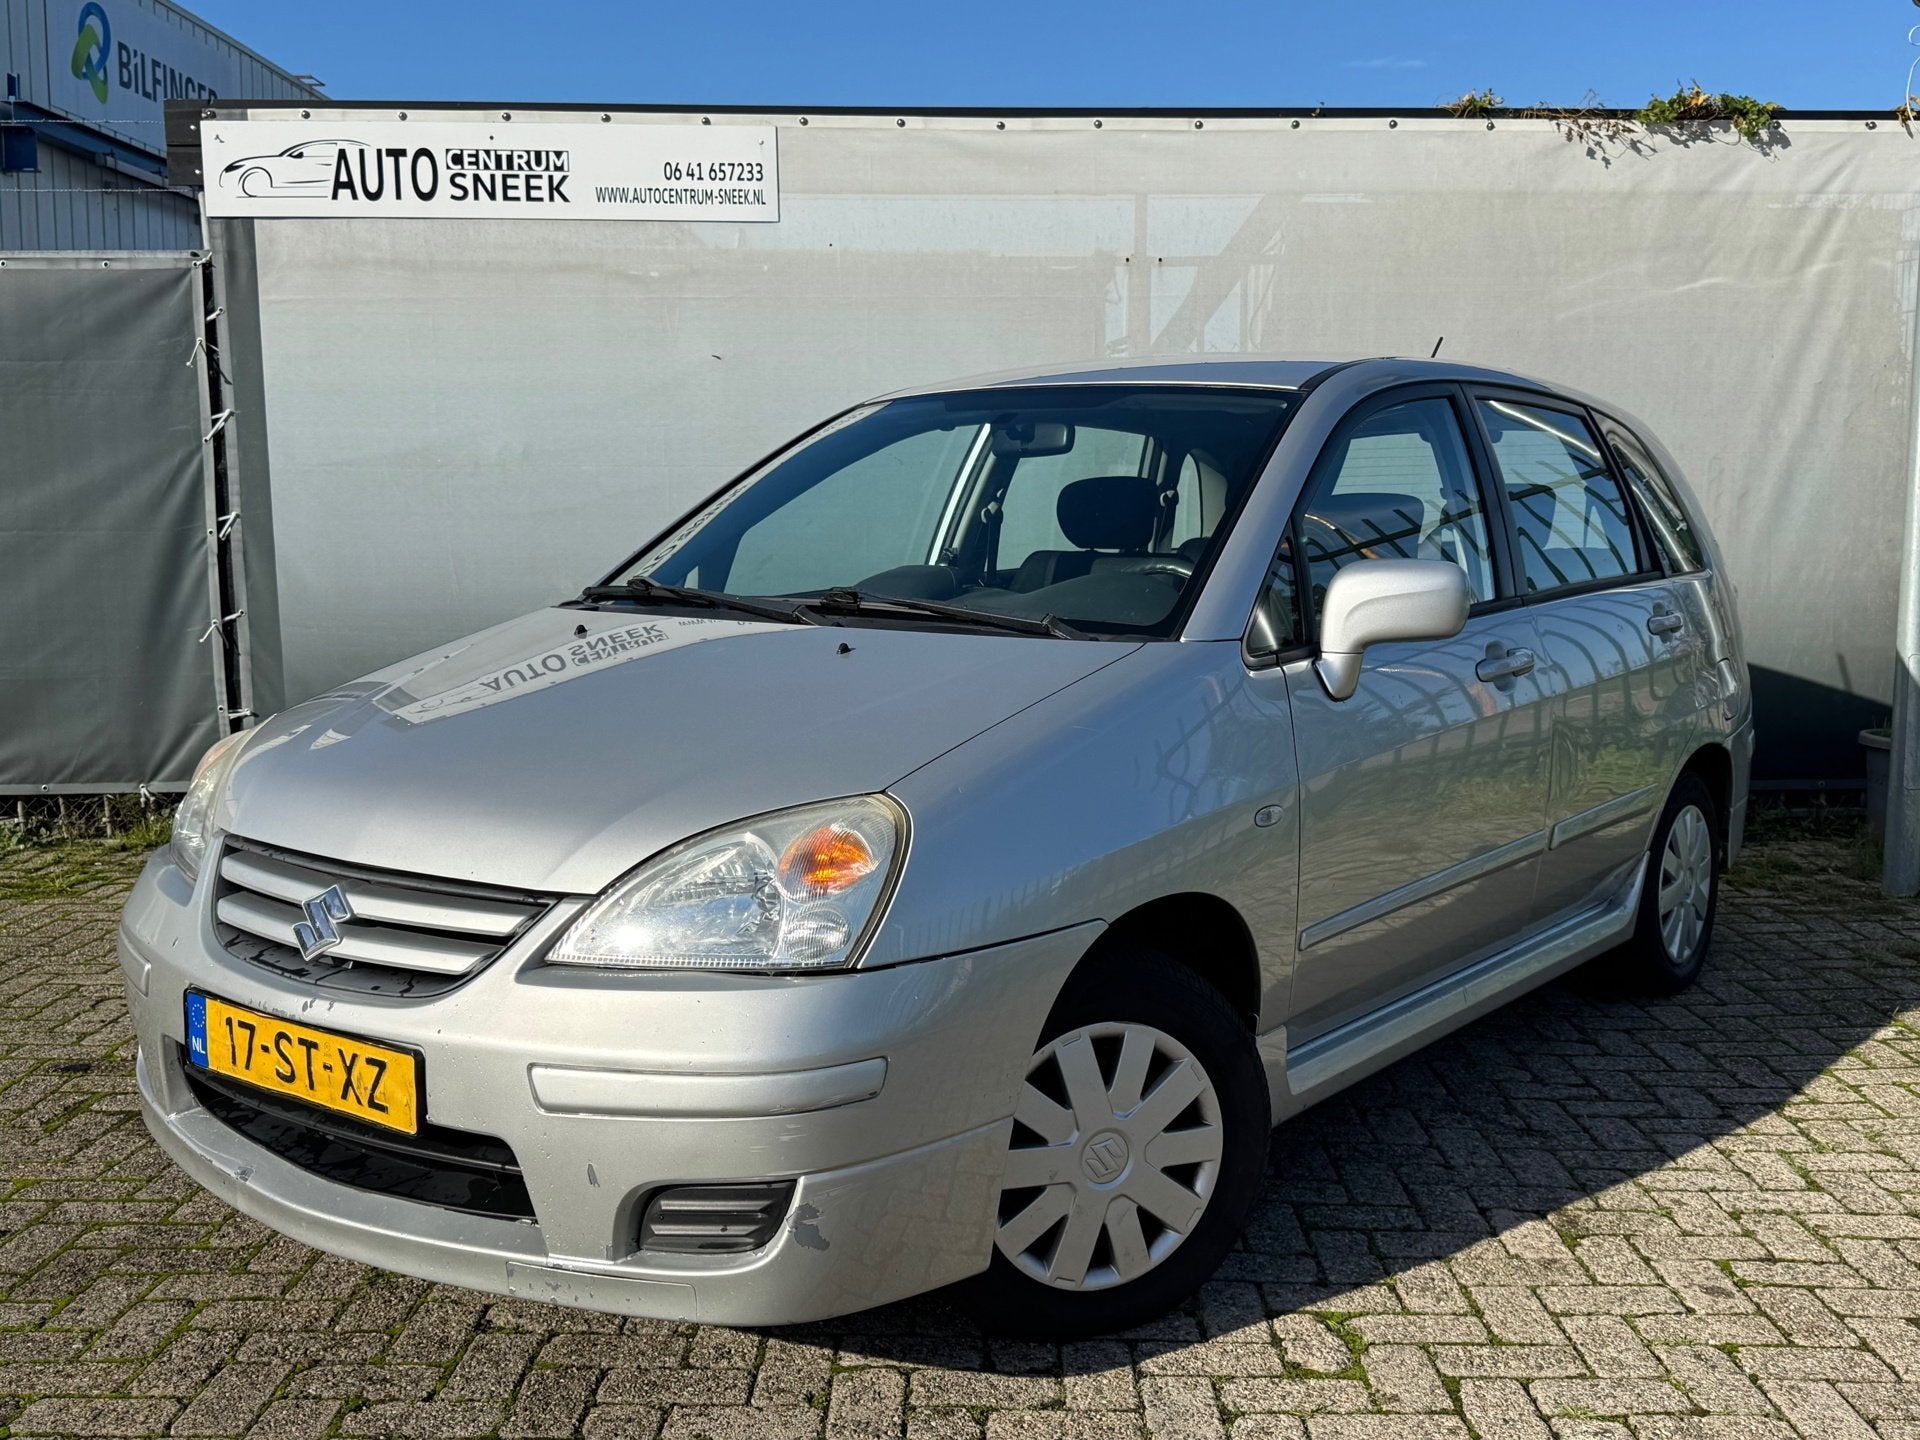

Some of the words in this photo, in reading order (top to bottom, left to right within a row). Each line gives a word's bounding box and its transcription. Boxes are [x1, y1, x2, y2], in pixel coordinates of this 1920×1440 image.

[446, 149, 570, 172] CENTRUM
[663, 161, 682, 181] 06
[686, 162, 704, 181] 41
[708, 162, 764, 182] 657233
[331, 147, 439, 202] AUTO
[450, 172, 571, 203] SNEEK
[595, 186, 767, 206] WWW.AUTOCENTRUM-SNEEK.NL
[192, 1035, 206, 1054] NL
[225, 1016, 389, 1115] 17-ST-XZ
